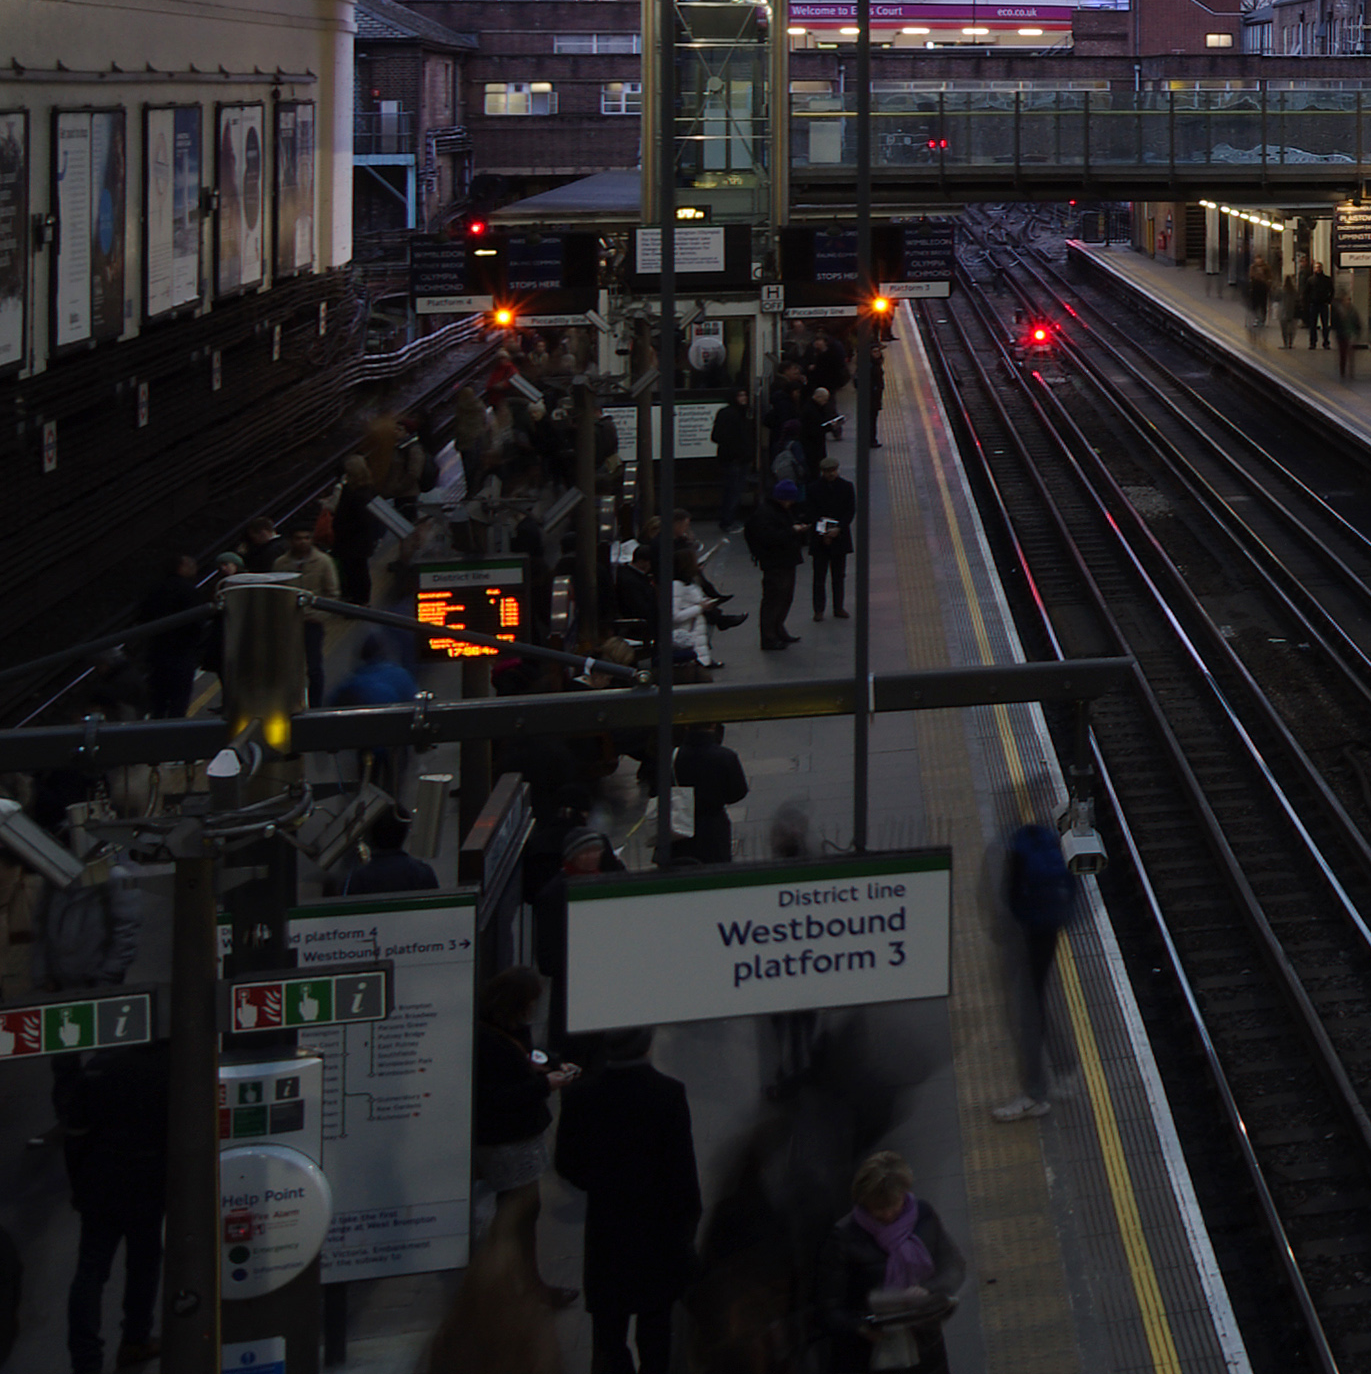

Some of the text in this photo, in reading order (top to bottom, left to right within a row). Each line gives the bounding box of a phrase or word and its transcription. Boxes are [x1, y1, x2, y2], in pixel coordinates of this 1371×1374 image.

[791, 5, 836, 16] Welcome
[837, 6, 848, 15] to
[875, 5, 903, 16] Court
[997, 8, 1037, 17] eco.co.uk
[905, 238, 952, 246] WIMBLEDON
[413, 250, 465, 258] WIMBLEDON
[420, 273, 458, 281] OLYMPIA
[816, 272, 842, 280] STOPS
[414, 283, 464, 292] RICHMOND
[509, 280, 561, 290] STOPS HERE
[889, 284, 924, 292] Platform
[768, 286, 779, 299] H
[426, 298, 464, 307] Platform
[763, 302, 782, 310] OFF
[432, 572, 490, 582] District line
[778, 883, 906, 907] District line
[718, 907, 906, 947] Westbound
[305, 927, 378, 944] platform 4
[303, 939, 457, 963] Westbound platform 3
[733, 941, 906, 988] platform 3
[404, 1012, 438, 1020] Broadway
[222, 1187, 305, 1208] Help Point
[273, 1208, 299, 1218] Alarm
[361, 1212, 376, 1221] the
[379, 1210, 398, 1219] first
[354, 1215, 437, 1231] at West Brompton
[253, 1242, 299, 1255] Emergency
[373, 1240, 431, 1253] Embankment
[336, 1252, 402, 1266] the subway to
[253, 1260, 304, 1275] Information
